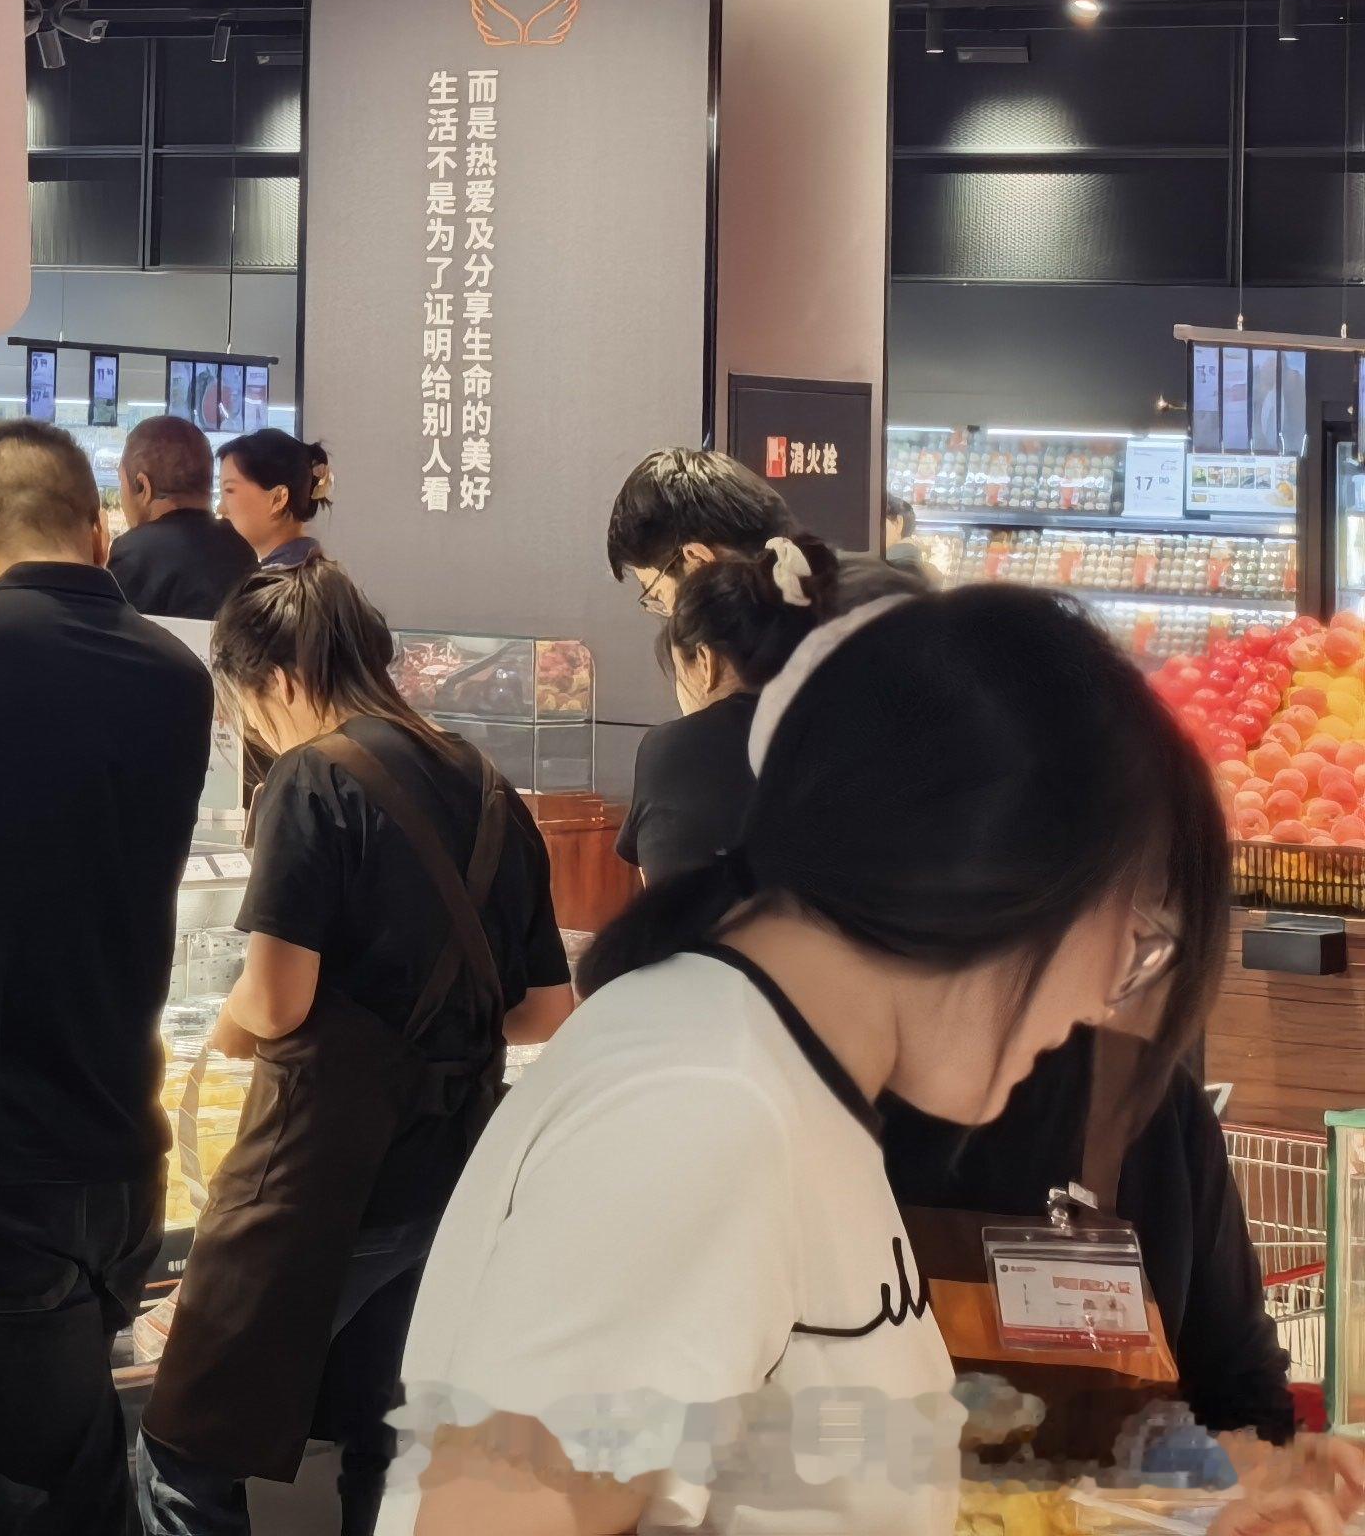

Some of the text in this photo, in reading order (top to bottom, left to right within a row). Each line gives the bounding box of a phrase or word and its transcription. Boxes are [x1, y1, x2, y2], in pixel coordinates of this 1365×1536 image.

[421, 70, 459, 513] 生活不是为了证明给别人看
[460, 69, 499, 510] 而是热爱及分享生命的美好
[790, 442, 838, 474] 消火栓
